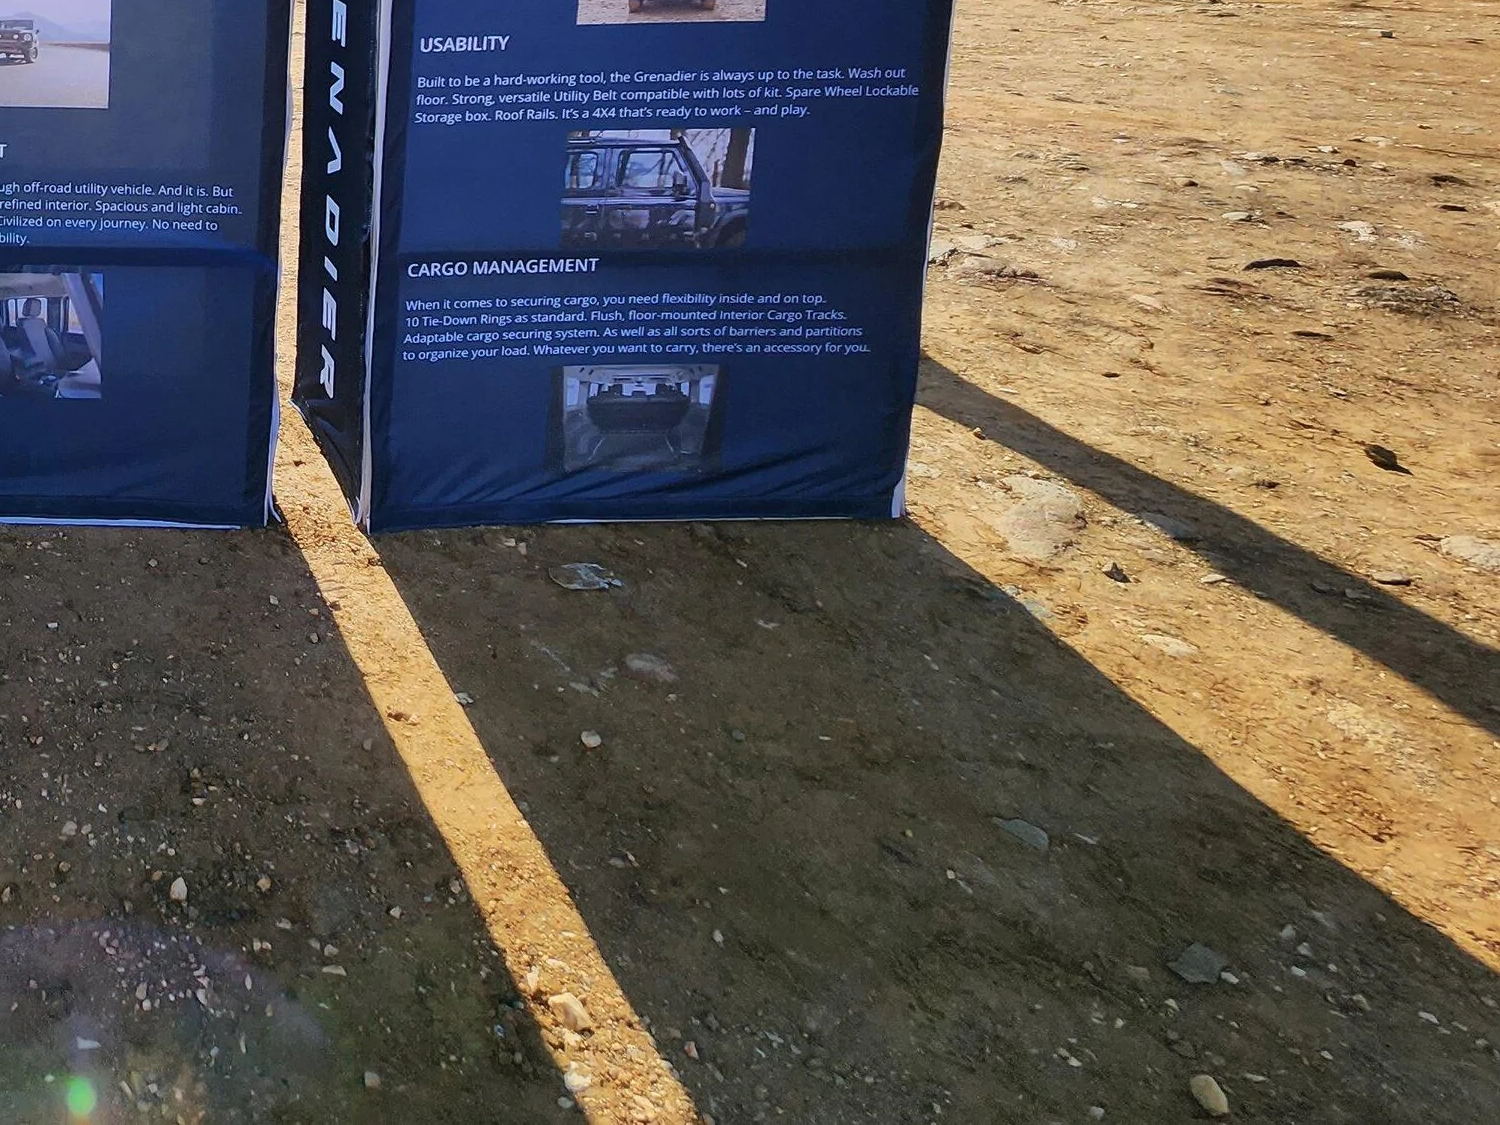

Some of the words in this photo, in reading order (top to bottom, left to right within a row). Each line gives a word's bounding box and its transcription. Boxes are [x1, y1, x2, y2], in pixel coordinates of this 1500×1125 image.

[420, 35, 510, 52] USABILITY
[416, 93, 448, 105] floor.
[451, 92, 495, 107] Strong,
[498, 90, 550, 103] versatile
[553, 90, 590, 104] Utility
[593, 89, 617, 100] Belt
[620, 88, 690, 103] compatible
[692, 87, 719, 98] with
[722, 86, 745, 98] lots
[748, 86, 762, 98] of
[764, 86, 782, 97] kit.
[785, 86, 821, 100] Spare
[824, 85, 862, 96] Wheel
[865, 84, 919, 96] Lockable
[407, 261, 467, 277] CARGO
[472, 257, 599, 274] MANAGEMENT
[405, 315, 419, 326] 10
[421, 314, 477, 326] Tie-Down
[480, 313, 512, 326] Rings
[513, 314, 528, 323] as
[530, 311, 587, 322] standard.
[590, 310, 625, 323] Flush,
[628, 309, 717, 320] floor-mounted
[719, 310, 764, 320] Interior
[766, 309, 802, 322] Cargo
[805, 309, 847, 319] Tracks.
